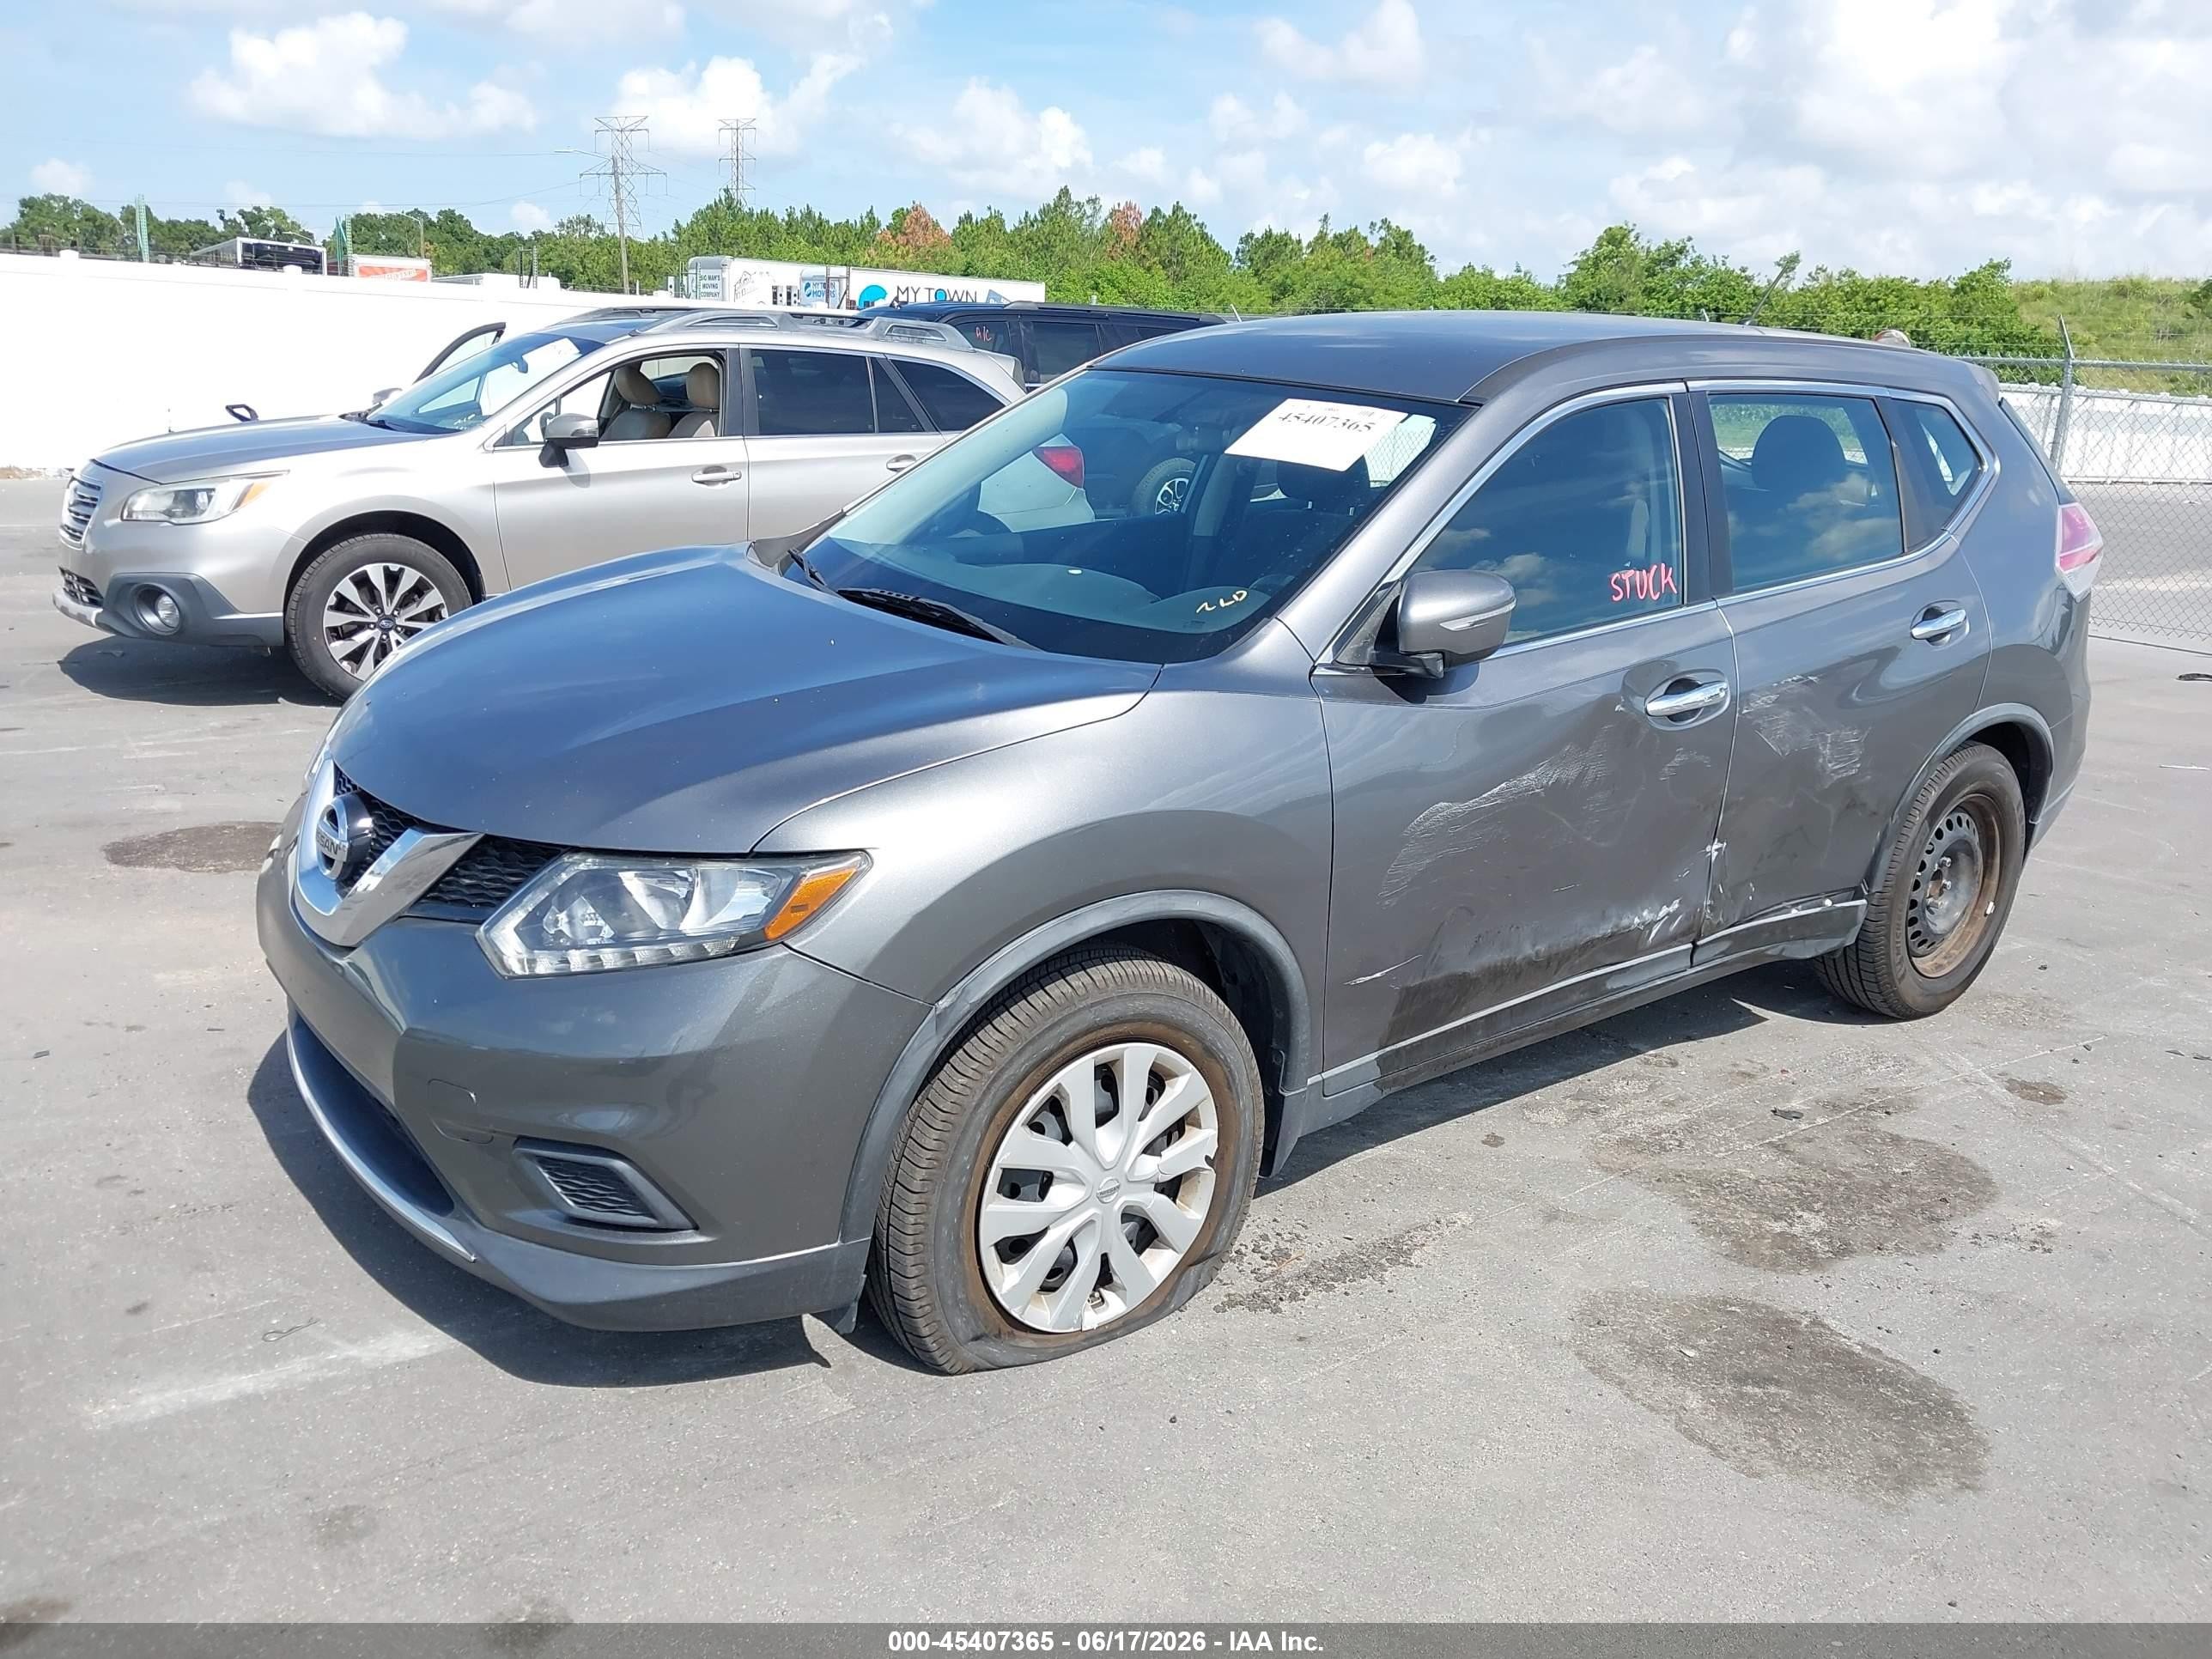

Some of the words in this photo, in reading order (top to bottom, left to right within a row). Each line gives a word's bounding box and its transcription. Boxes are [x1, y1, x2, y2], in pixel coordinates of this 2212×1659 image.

[896, 285, 921, 302] MY
[924, 287, 977, 303] TOWN
[1279, 413, 1376, 432] 45407365
[1611, 562, 1678, 601] STUCK
